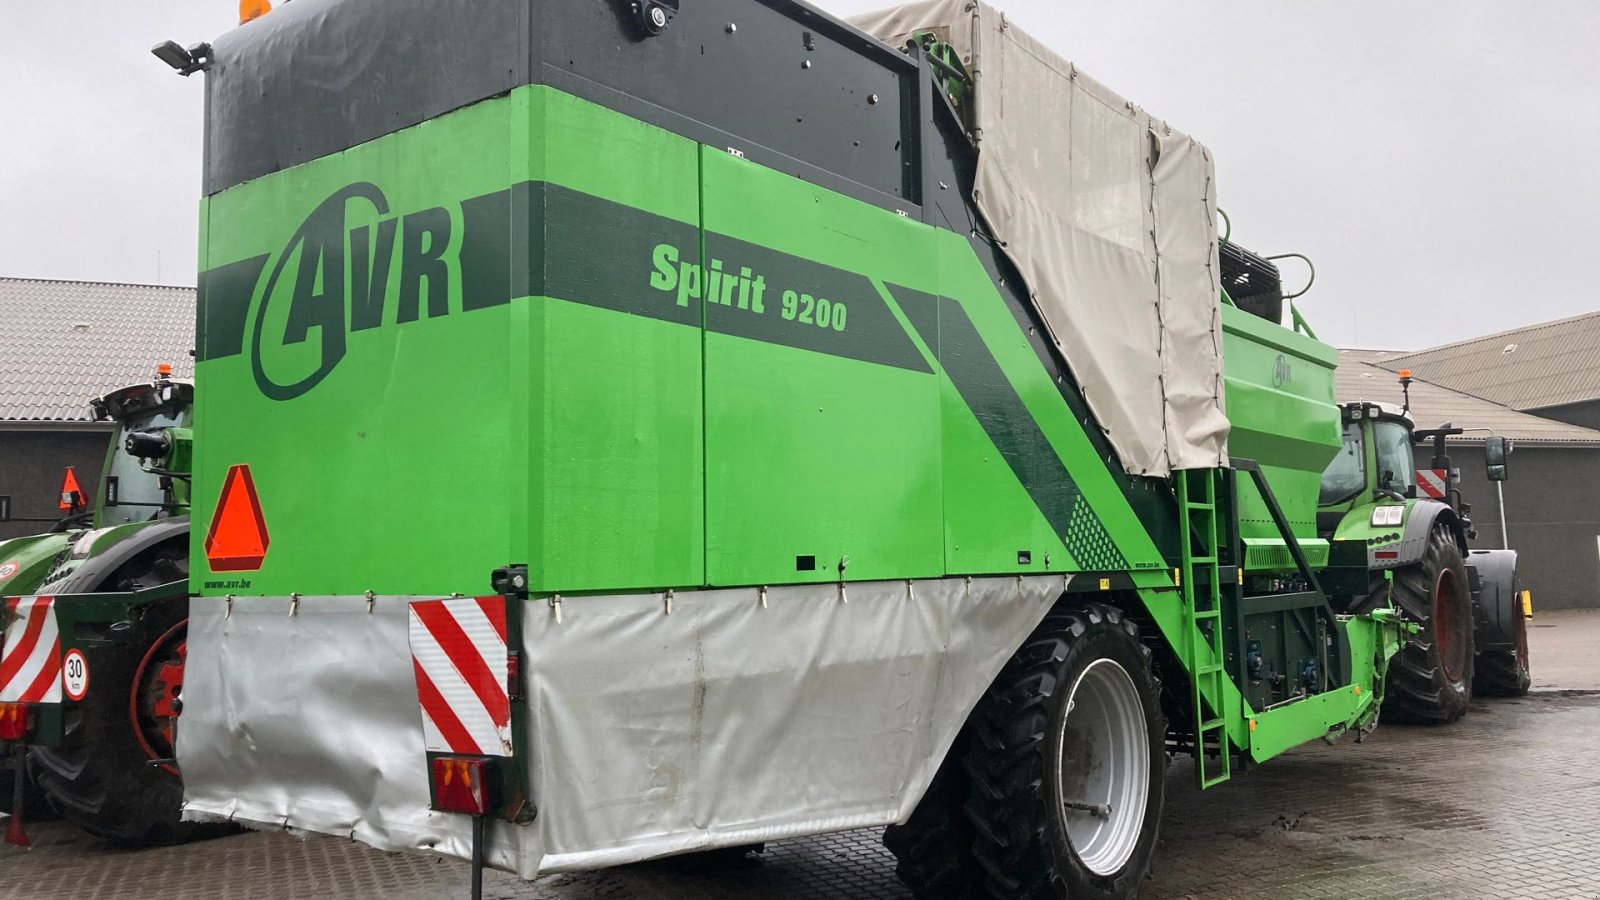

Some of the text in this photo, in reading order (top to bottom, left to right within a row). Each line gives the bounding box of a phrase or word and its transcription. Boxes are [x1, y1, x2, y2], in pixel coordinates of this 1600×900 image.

[251, 181, 452, 401] AVR
[650, 243, 848, 332] Spirit 9200
[204, 578, 251, 589] www.avr.be
[68, 658, 83, 678] 30
